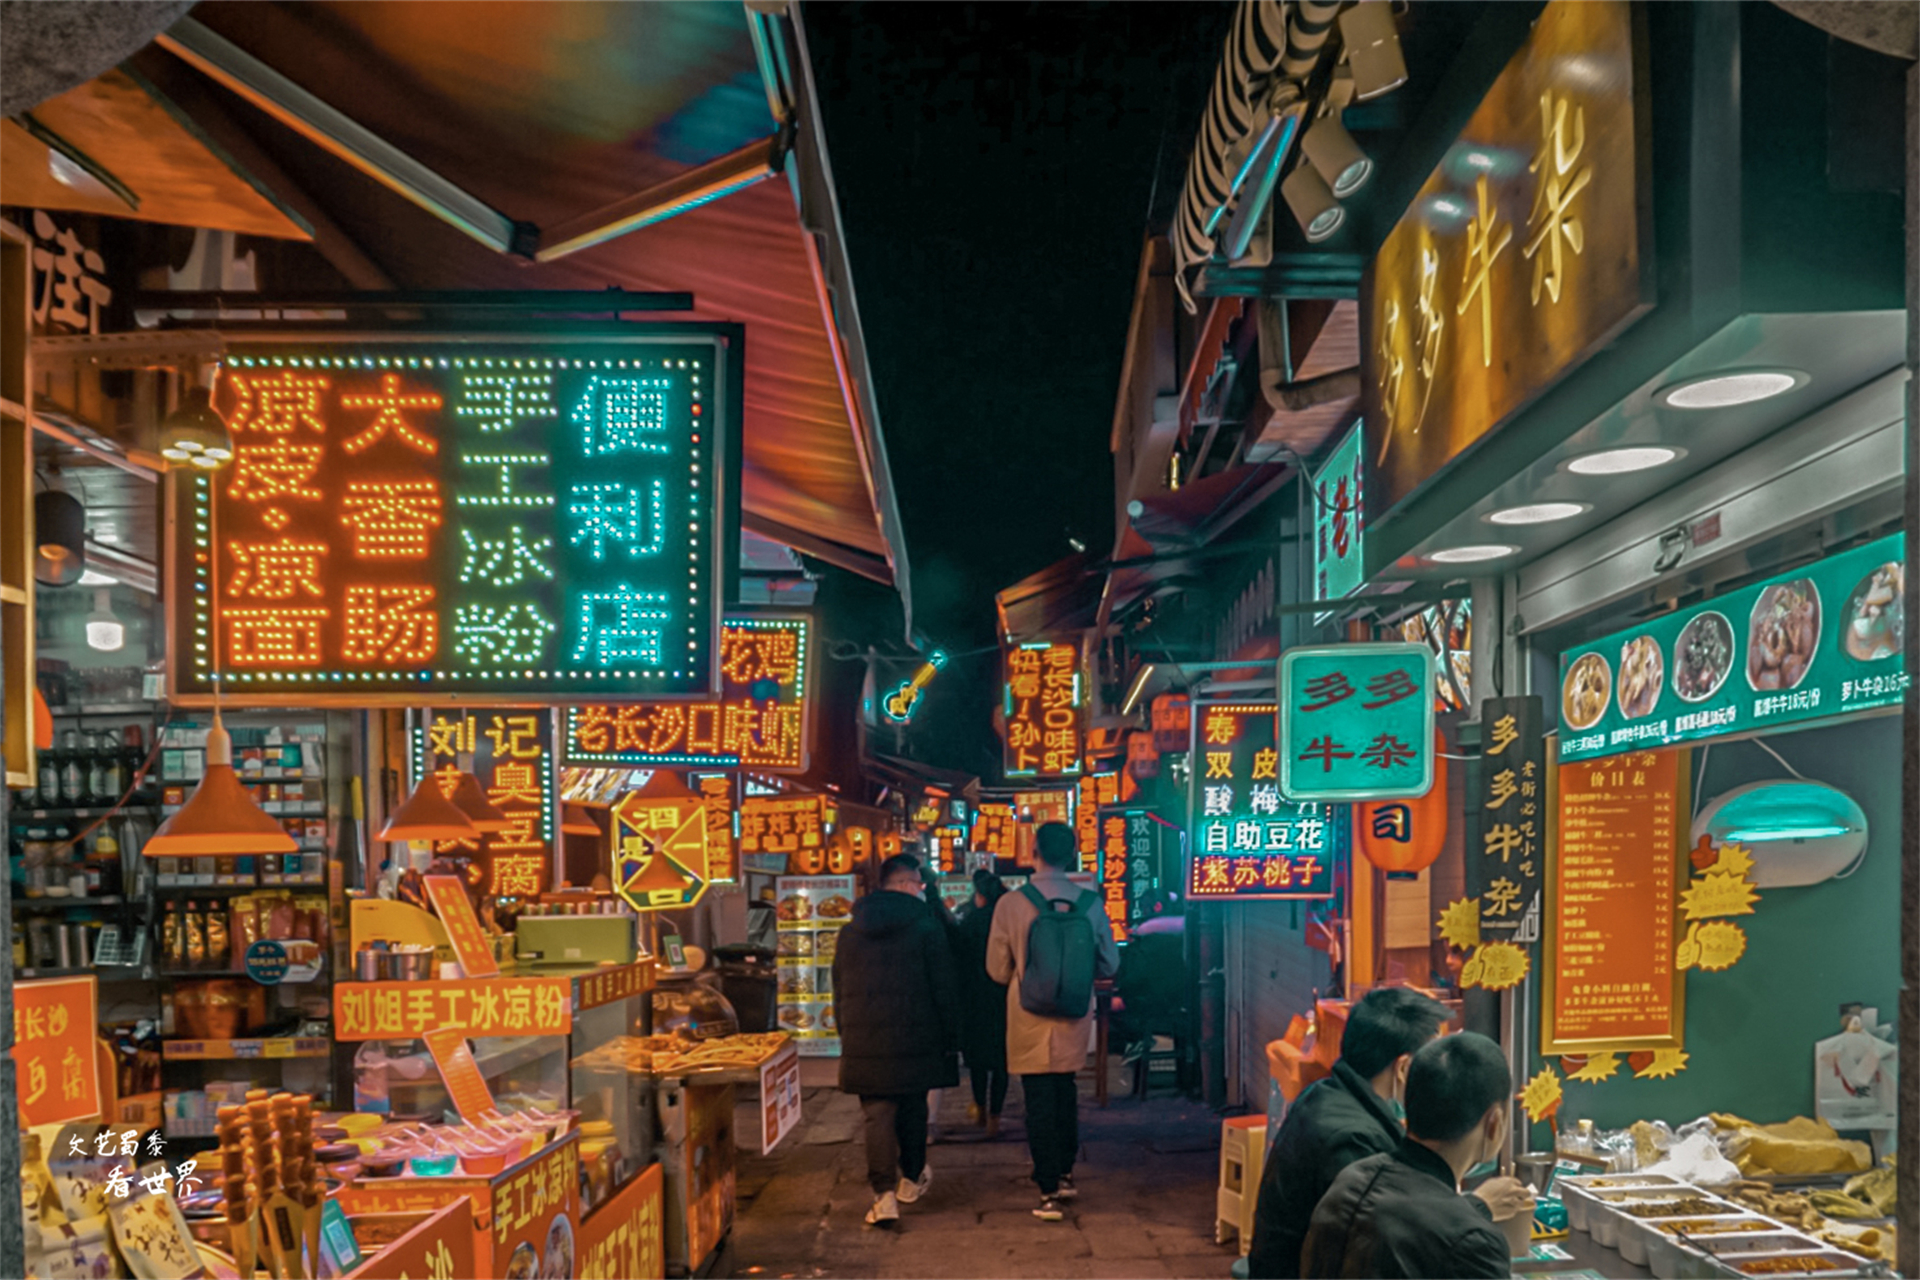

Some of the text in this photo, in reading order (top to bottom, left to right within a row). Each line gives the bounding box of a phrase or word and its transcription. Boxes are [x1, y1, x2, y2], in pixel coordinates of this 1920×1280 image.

[340, 373, 443, 662] 大香肠
[454, 374, 558, 665] 手工冰粉
[569, 373, 672, 667] 便利店
[1041, 643, 1076, 773] 老长沙口味虾
[1300, 668, 1420, 712] 多多
[429, 715, 541, 758] 刘记
[575, 701, 801, 757] 老长沙口味虾
[1299, 733, 1419, 773] 牛杂
[487, 762, 543, 897] 臭豆腐
[631, 806, 679, 831] 酒
[1205, 819, 1325, 852] 自助豆花
[1371, 803, 1412, 843] 司
[1482, 713, 1523, 918] 多多牛杂
[1202, 854, 1324, 887] 紫苏桃子
[341, 984, 564, 1034] 刘姐手工冰凉粉
[494, 1144, 577, 1245] 手工冰凉粉
